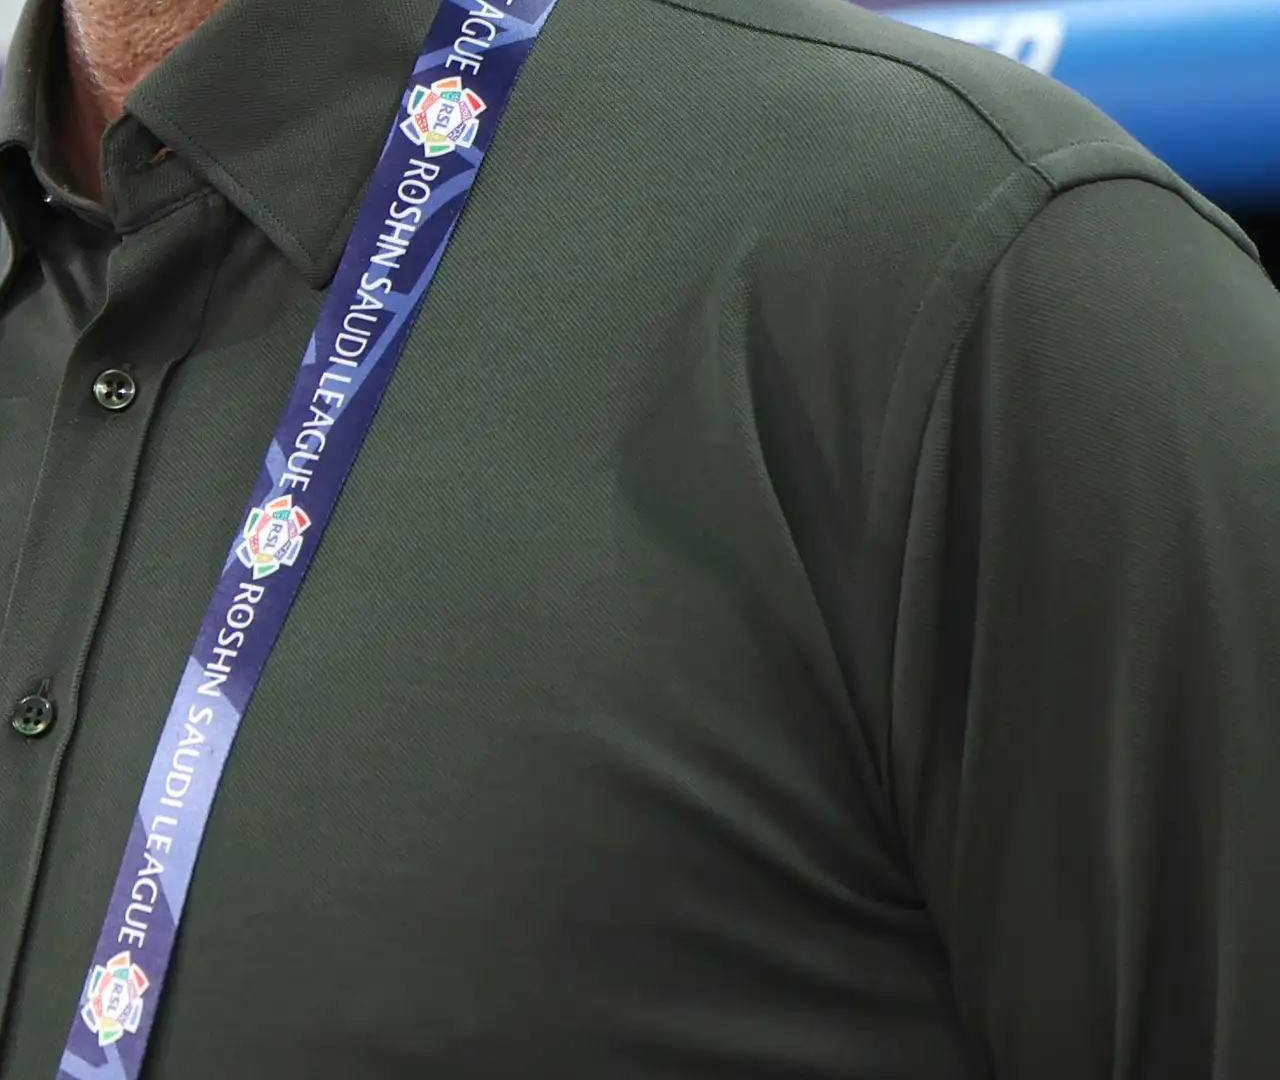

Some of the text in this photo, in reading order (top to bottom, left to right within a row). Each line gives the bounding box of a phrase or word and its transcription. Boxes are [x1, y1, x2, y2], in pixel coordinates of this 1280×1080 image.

[432, 104, 454, 131] RSL
[279, 158, 440, 491] ROSHN SAUDI LEAGUE
[262, 523, 283, 550] RSL
[118, 582, 264, 948] ROSHN SAUDI LEAGUE
[107, 983, 124, 1013] RSL
